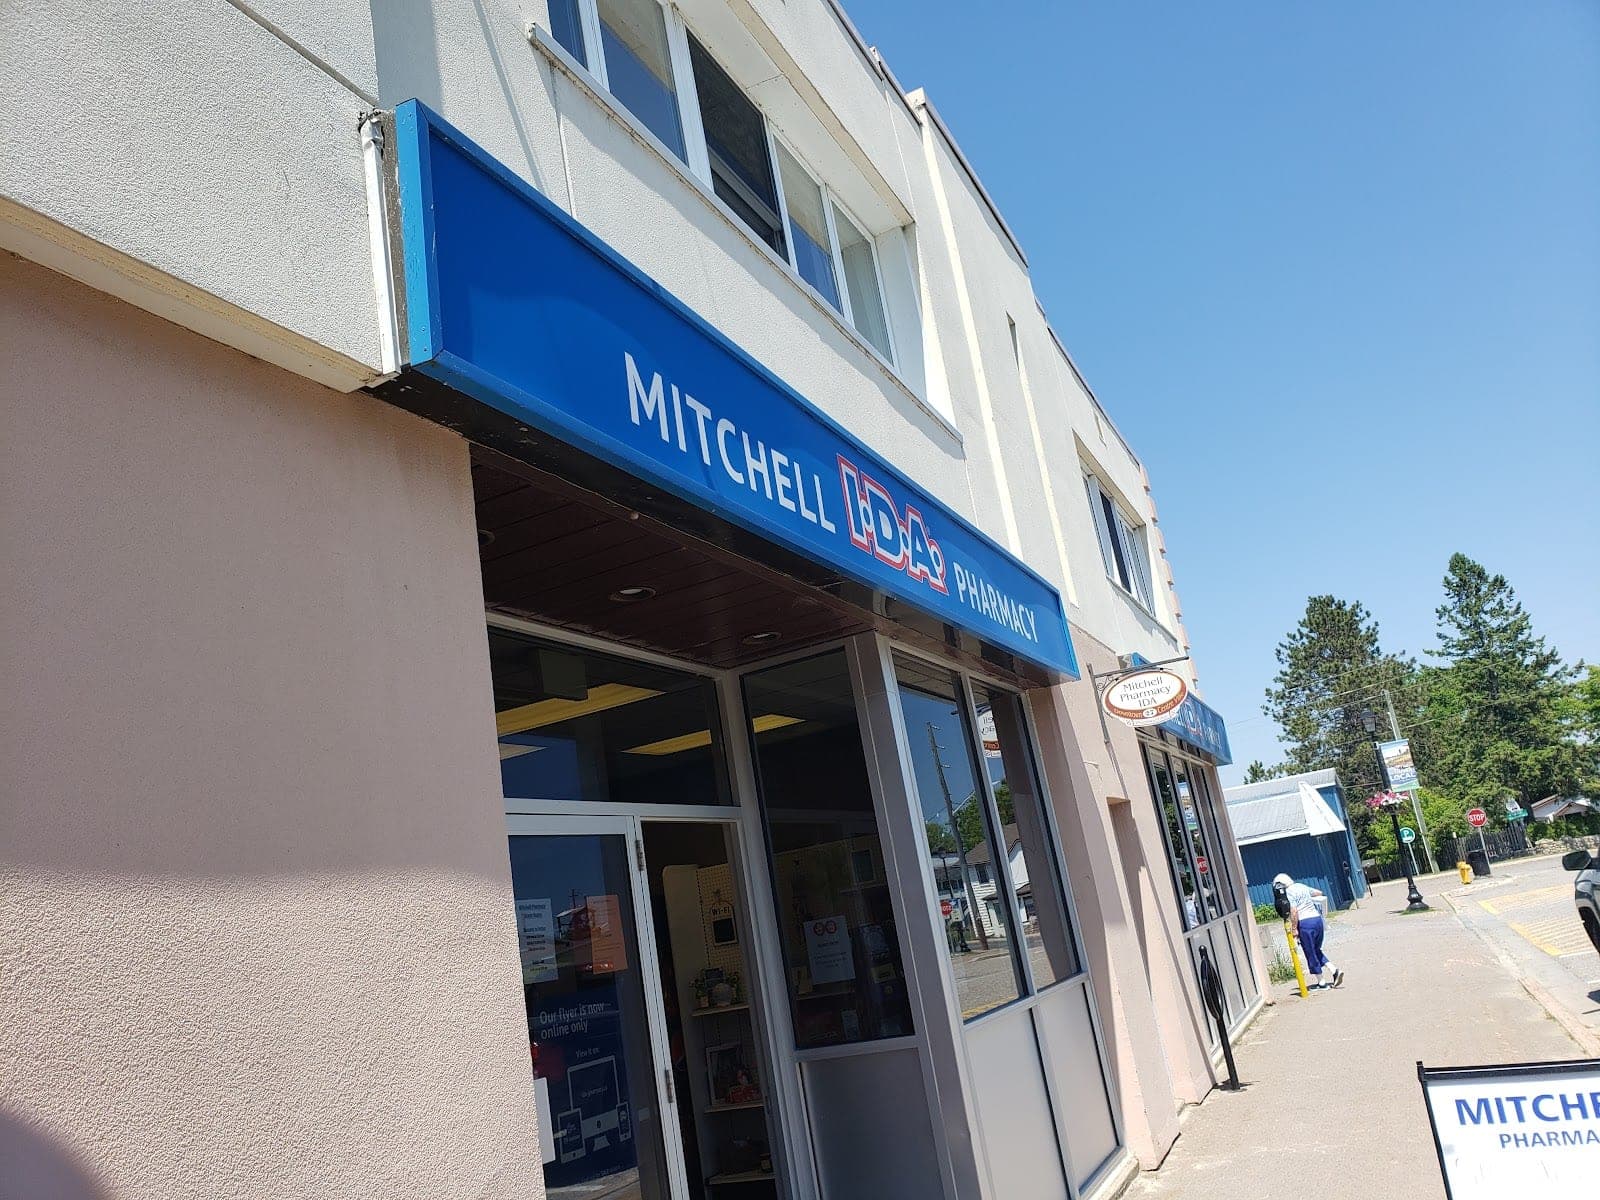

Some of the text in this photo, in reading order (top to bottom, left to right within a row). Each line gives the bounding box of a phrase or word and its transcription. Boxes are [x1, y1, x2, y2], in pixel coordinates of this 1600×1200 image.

[624, 351, 836, 535] MITCHELL
[952, 560, 1038, 644] PHARMACY
[1120, 684, 1171, 702] Pharmacy
[1122, 676, 1163, 692] Mitchell
[1138, 697, 1157, 708] IDA
[1389, 772, 1417, 782] LOCAL
[1468, 813, 1485, 822] STOP
[539, 1002, 604, 1024] Our flyer is now
[540, 1018, 588, 1040] online only
[1455, 1091, 1600, 1125] MITCHE
[1499, 1129, 1600, 1149] PHARMA
